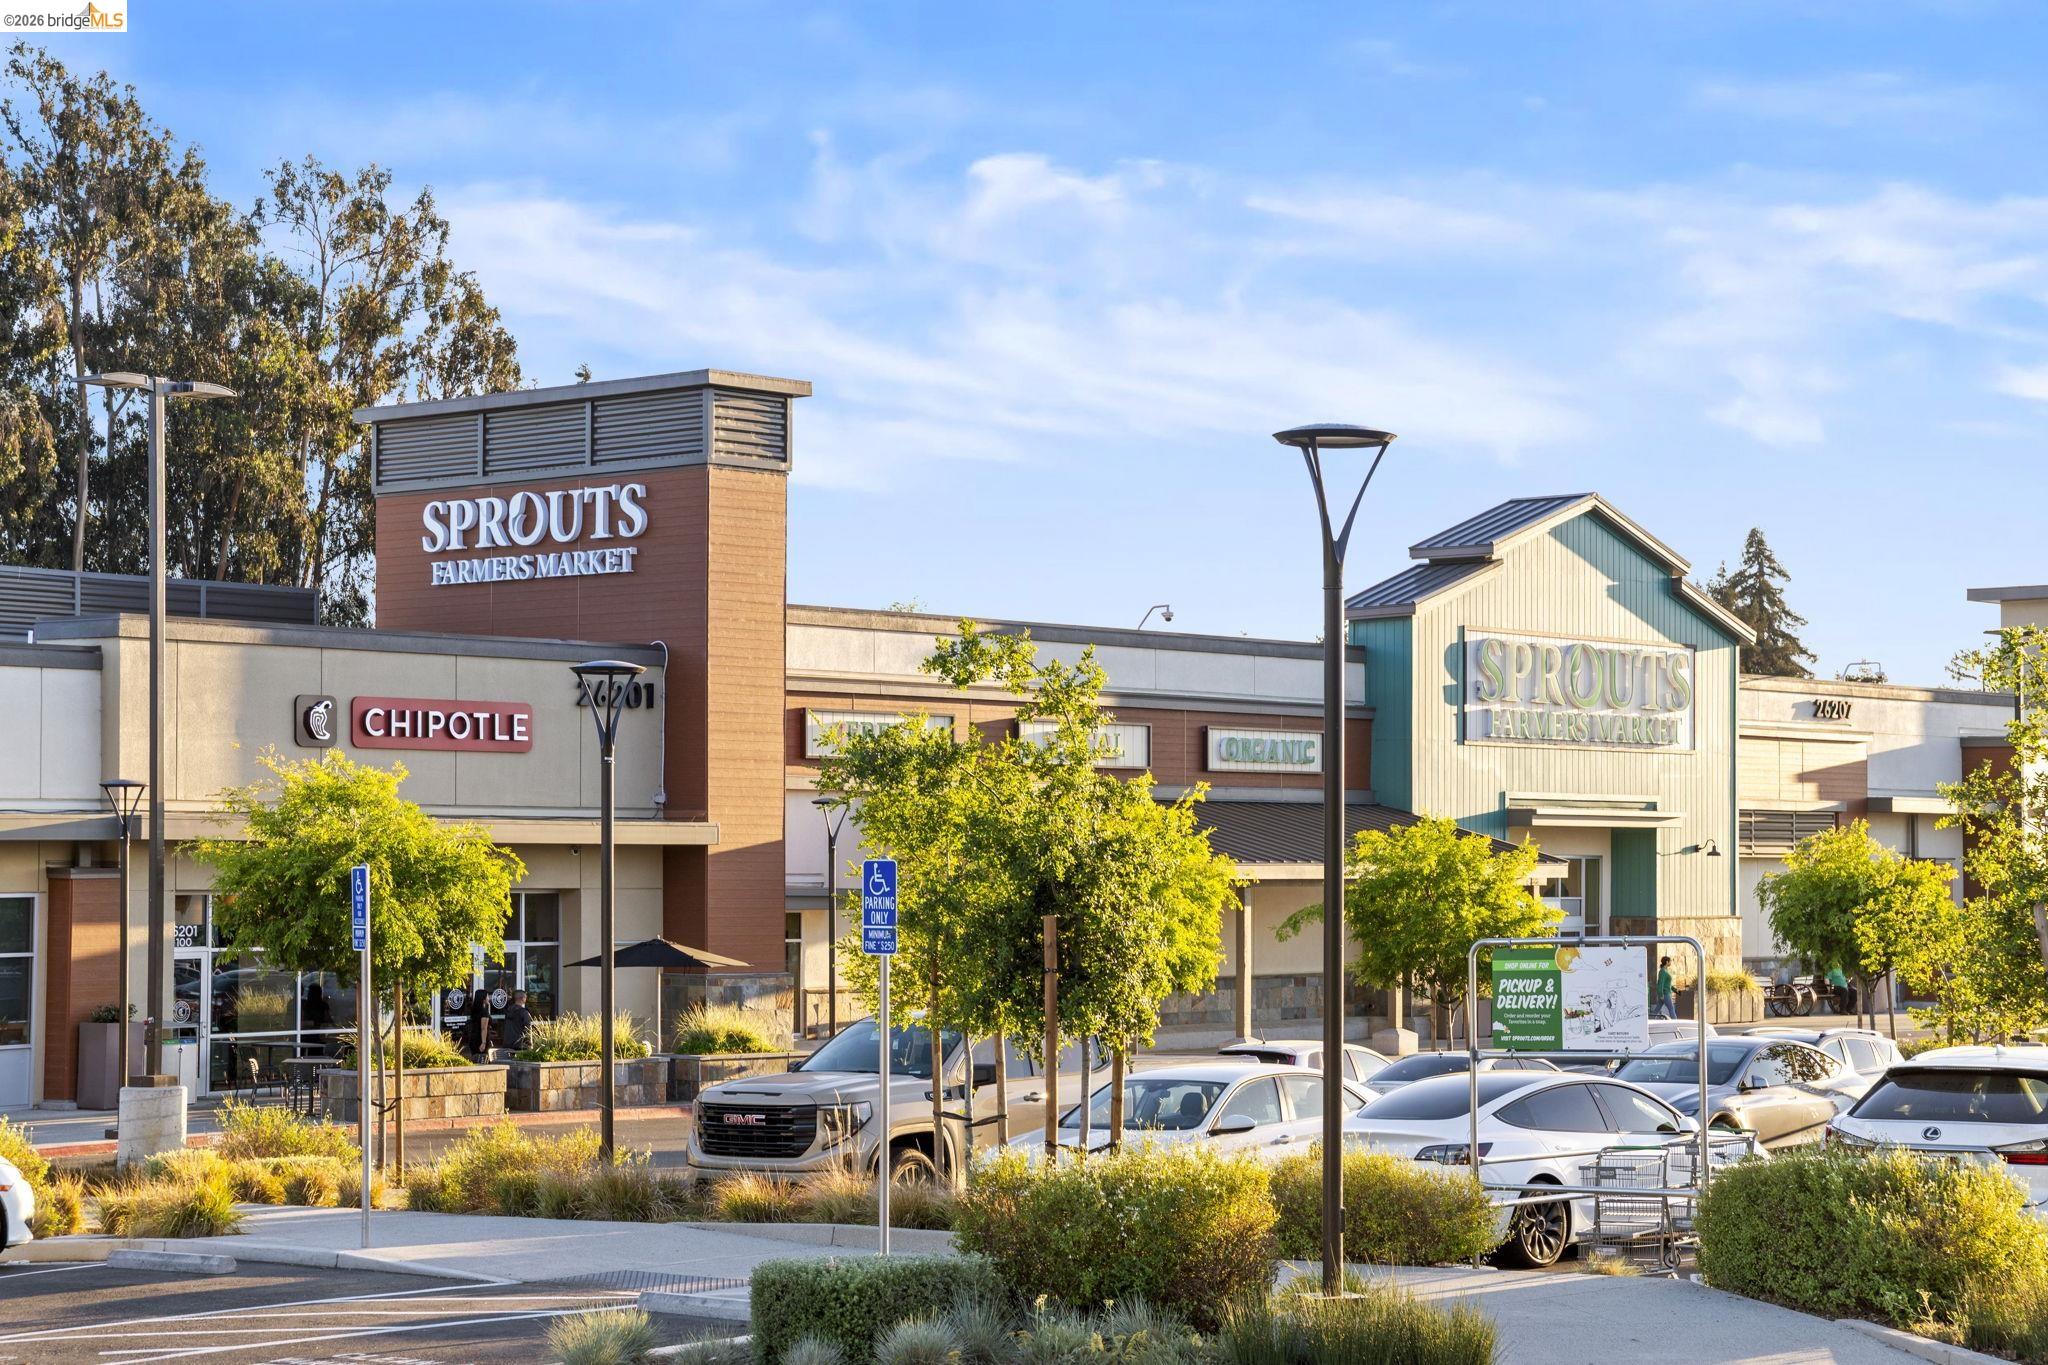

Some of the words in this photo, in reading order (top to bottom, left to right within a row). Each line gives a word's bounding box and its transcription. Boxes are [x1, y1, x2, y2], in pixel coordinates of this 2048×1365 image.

[422, 483, 648, 553] SPROUTS
[431, 555, 534, 586] FARMERS
[535, 547, 637, 579] MARKET
[1477, 638, 1691, 712] SPROUTS
[576, 679, 655, 709] 26201
[1813, 699, 1852, 719] 26207
[364, 707, 529, 741] CHIPOTLE
[1486, 707, 1591, 742] FARMERS
[1592, 713, 1682, 745] MARKET
[1218, 737, 1315, 764] ORGANIC
[865, 896, 895, 910] PARKING
[870, 911, 888, 925] ONLY
[176, 938, 192, 947] 100
[865, 941, 877, 950] FINE
[881, 941, 895, 951] $250
[1499, 978, 1542, 993] PICKUP
[1545, 978, 1554, 993] &
[1496, 994, 1558, 1009] DELIVERY!
[724, 1113, 766, 1126] GMC
